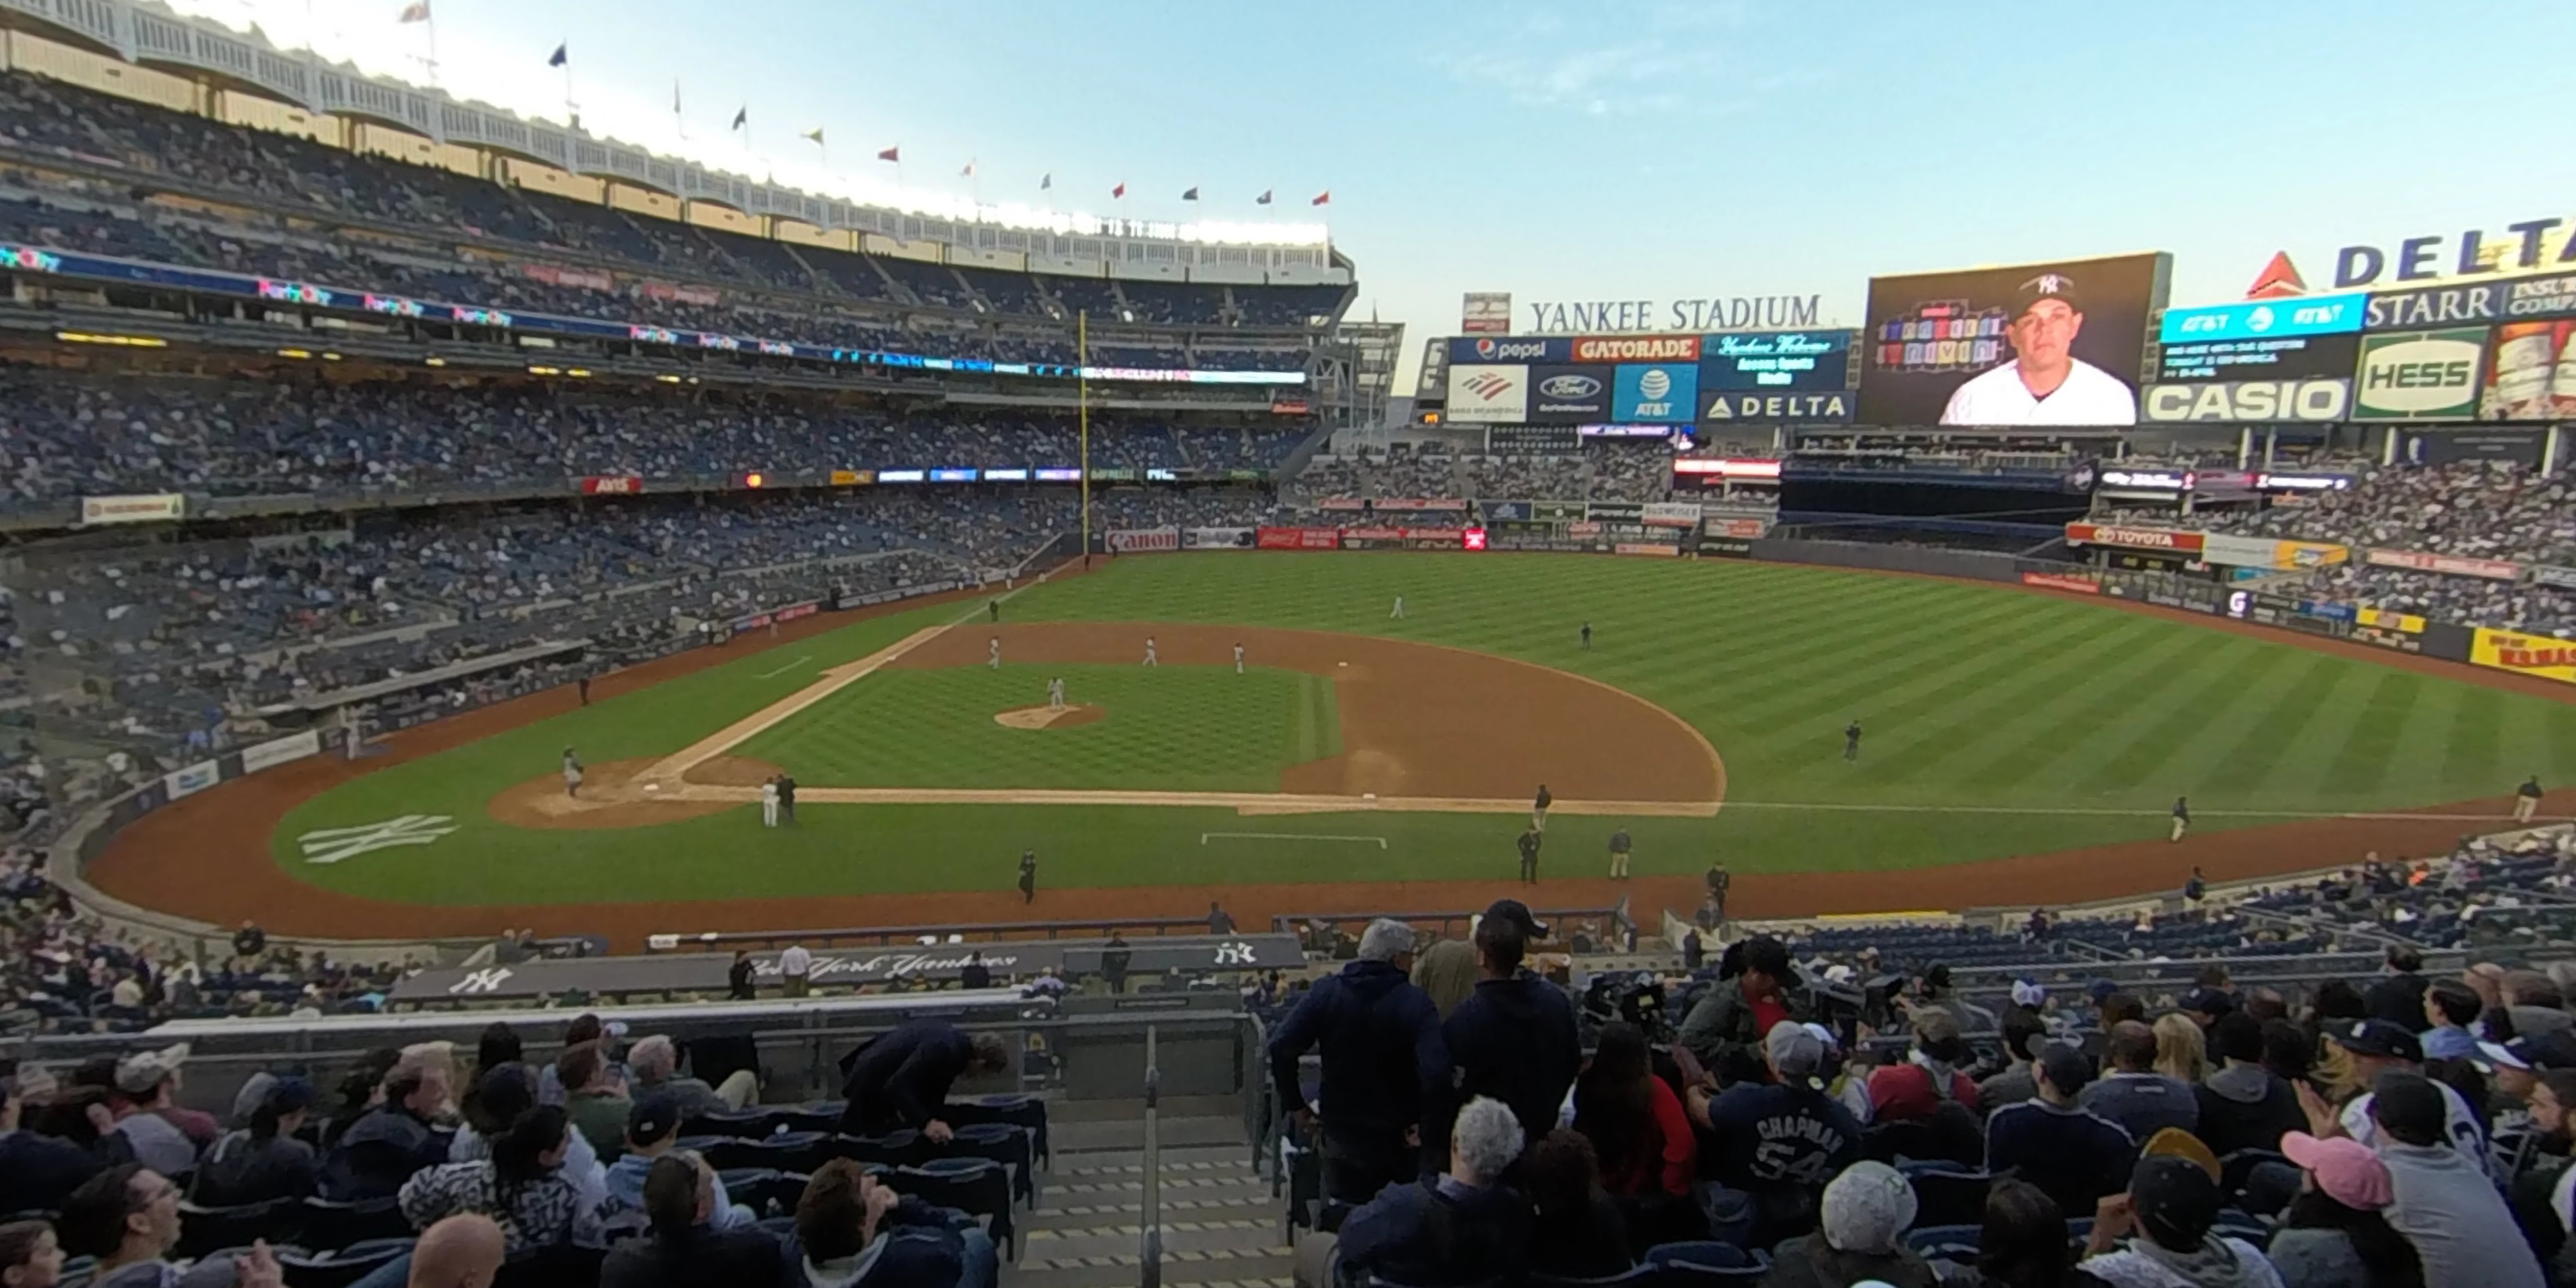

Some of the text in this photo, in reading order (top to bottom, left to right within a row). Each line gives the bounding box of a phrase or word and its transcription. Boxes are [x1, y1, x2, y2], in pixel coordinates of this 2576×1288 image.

[1530, 295, 1821, 332] YANKEE STADIUM
[2367, 287, 2494, 327] STARR
[1498, 341, 1546, 360] pepsi
[1580, 338, 1693, 358] GATORADE
[2370, 360, 2470, 389] HESS
[1551, 378, 1589, 395] Ford
[1635, 403, 1673, 416] AT&T
[1741, 396, 1845, 417] DELTA
[2149, 381, 2344, 421] CASIO
[1108, 532, 1176, 548] Canon
[2117, 530, 2173, 546] TOYOTA
[1756, 1116, 1844, 1154] CHAPMAN
[1749, 1141, 1834, 1184] 54
